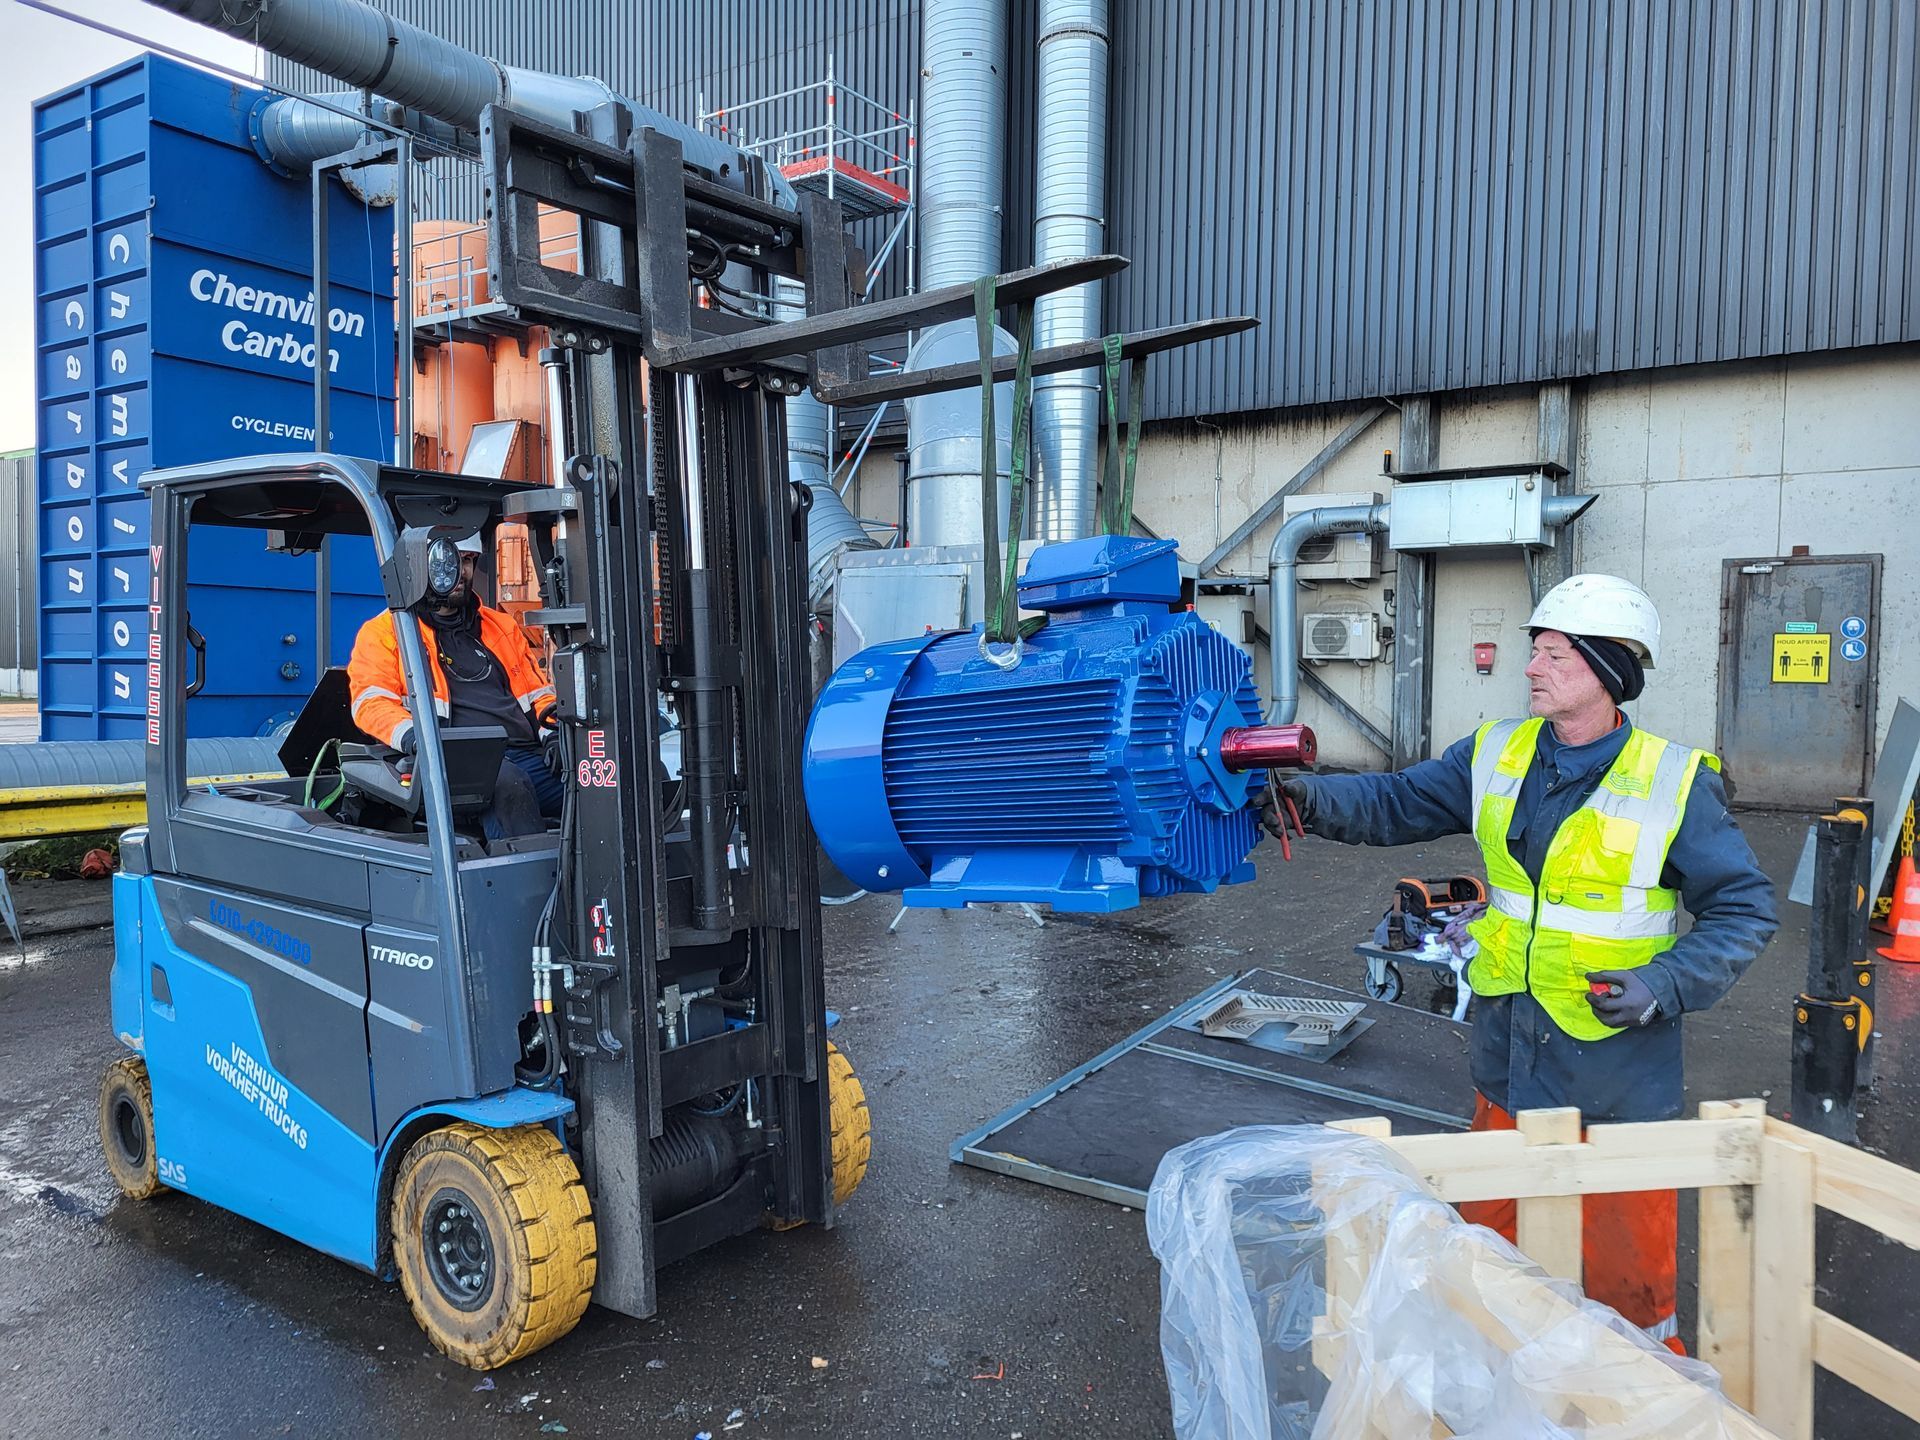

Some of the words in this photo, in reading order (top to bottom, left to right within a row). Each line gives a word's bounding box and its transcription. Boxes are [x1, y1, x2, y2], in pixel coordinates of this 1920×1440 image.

[190, 269, 365, 337] Chemvion
[65, 301, 85, 594] Carbon
[231, 415, 316, 442] CYCLEVEN
[109, 233, 136, 700] Chemviron
[148, 545, 162, 745] VITESSE
[578, 759, 617, 787] 632
[588, 730, 605, 757] E
[206, 1044, 308, 1150] VORKHEFTRUCKS
[231, 1042, 289, 1109] VERHUUR
[159, 1157, 187, 1184] SAS
